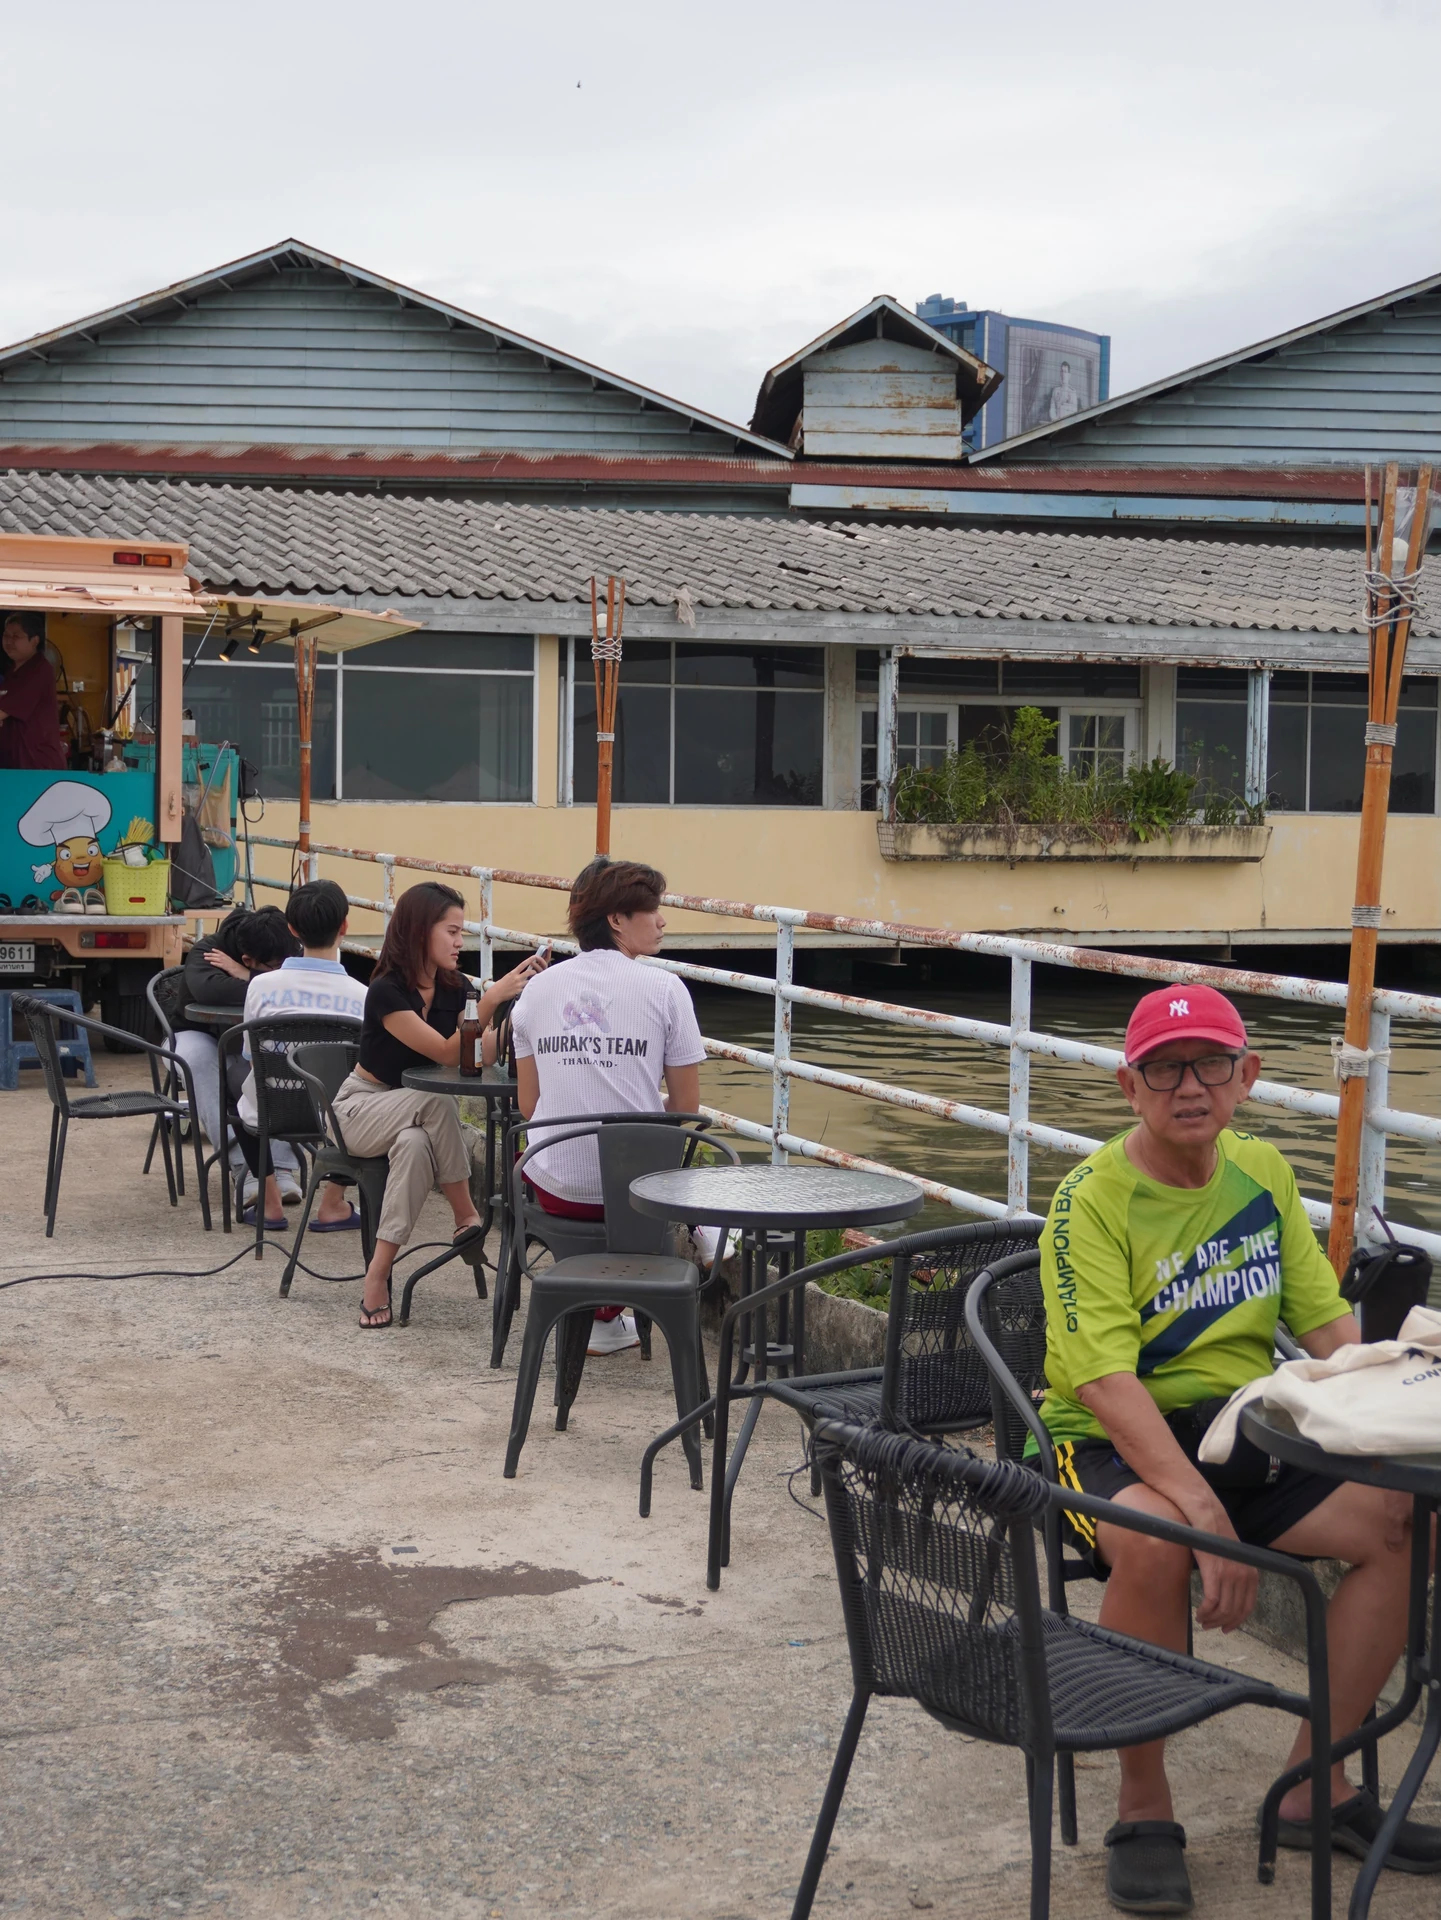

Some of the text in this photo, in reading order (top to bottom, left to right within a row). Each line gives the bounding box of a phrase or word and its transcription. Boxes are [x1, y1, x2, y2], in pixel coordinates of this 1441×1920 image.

[0, 946, 31, 960] 9611
[262, 988, 363, 1017] MARCUS
[1169, 998, 1190, 1017] NY
[537, 1034, 648, 1057] ANURAK'S TEAM
[1055, 1165, 1094, 1213] BAGS
[1195, 1239, 1231, 1270] ARE
[1239, 1230, 1279, 1262] THE
[1153, 1261, 1280, 1313] CHAMPION
[1402, 1368, 1441, 1385] CON
